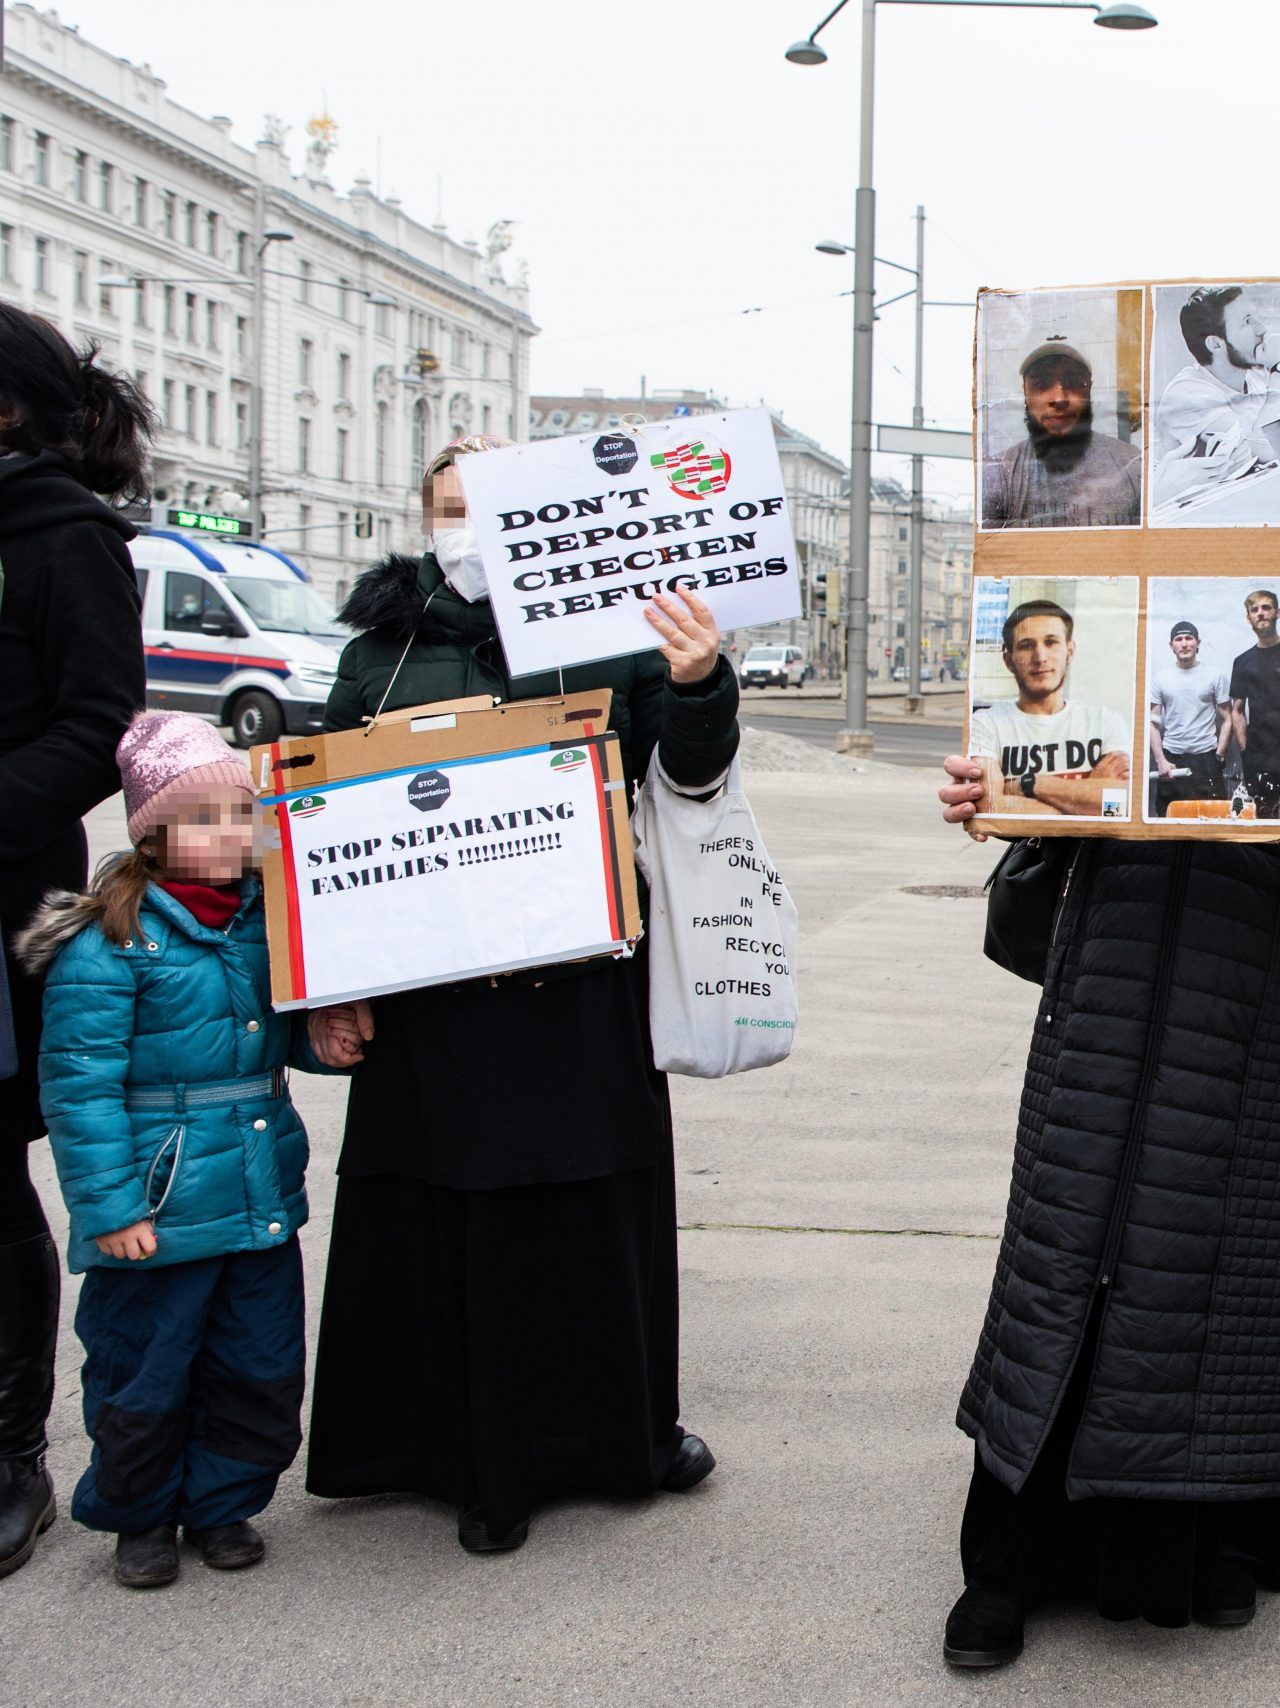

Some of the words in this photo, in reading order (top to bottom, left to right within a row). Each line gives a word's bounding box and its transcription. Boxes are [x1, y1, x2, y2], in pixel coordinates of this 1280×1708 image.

[603, 441, 623, 451] STOP
[595, 451, 637, 464] Deportation
[496, 488, 650, 532] DON'T
[504, 507, 714, 563] DEPORT
[729, 497, 784, 521] OF
[513, 531, 758, 592] CHECHEN
[521, 557, 789, 624] REFUGEES
[1065, 739, 1103, 770] DO
[418, 779, 438, 788] STOP
[409, 787, 449, 800] Deportation
[307, 838, 382, 869] STOP
[391, 801, 575, 854] SEPARATING
[699, 837, 754, 854] THERE'S
[311, 852, 450, 897] FAMILIES
[740, 896, 753, 909] IN
[693, 915, 753, 928] FASHION
[695, 980, 771, 997] CLOTHES
